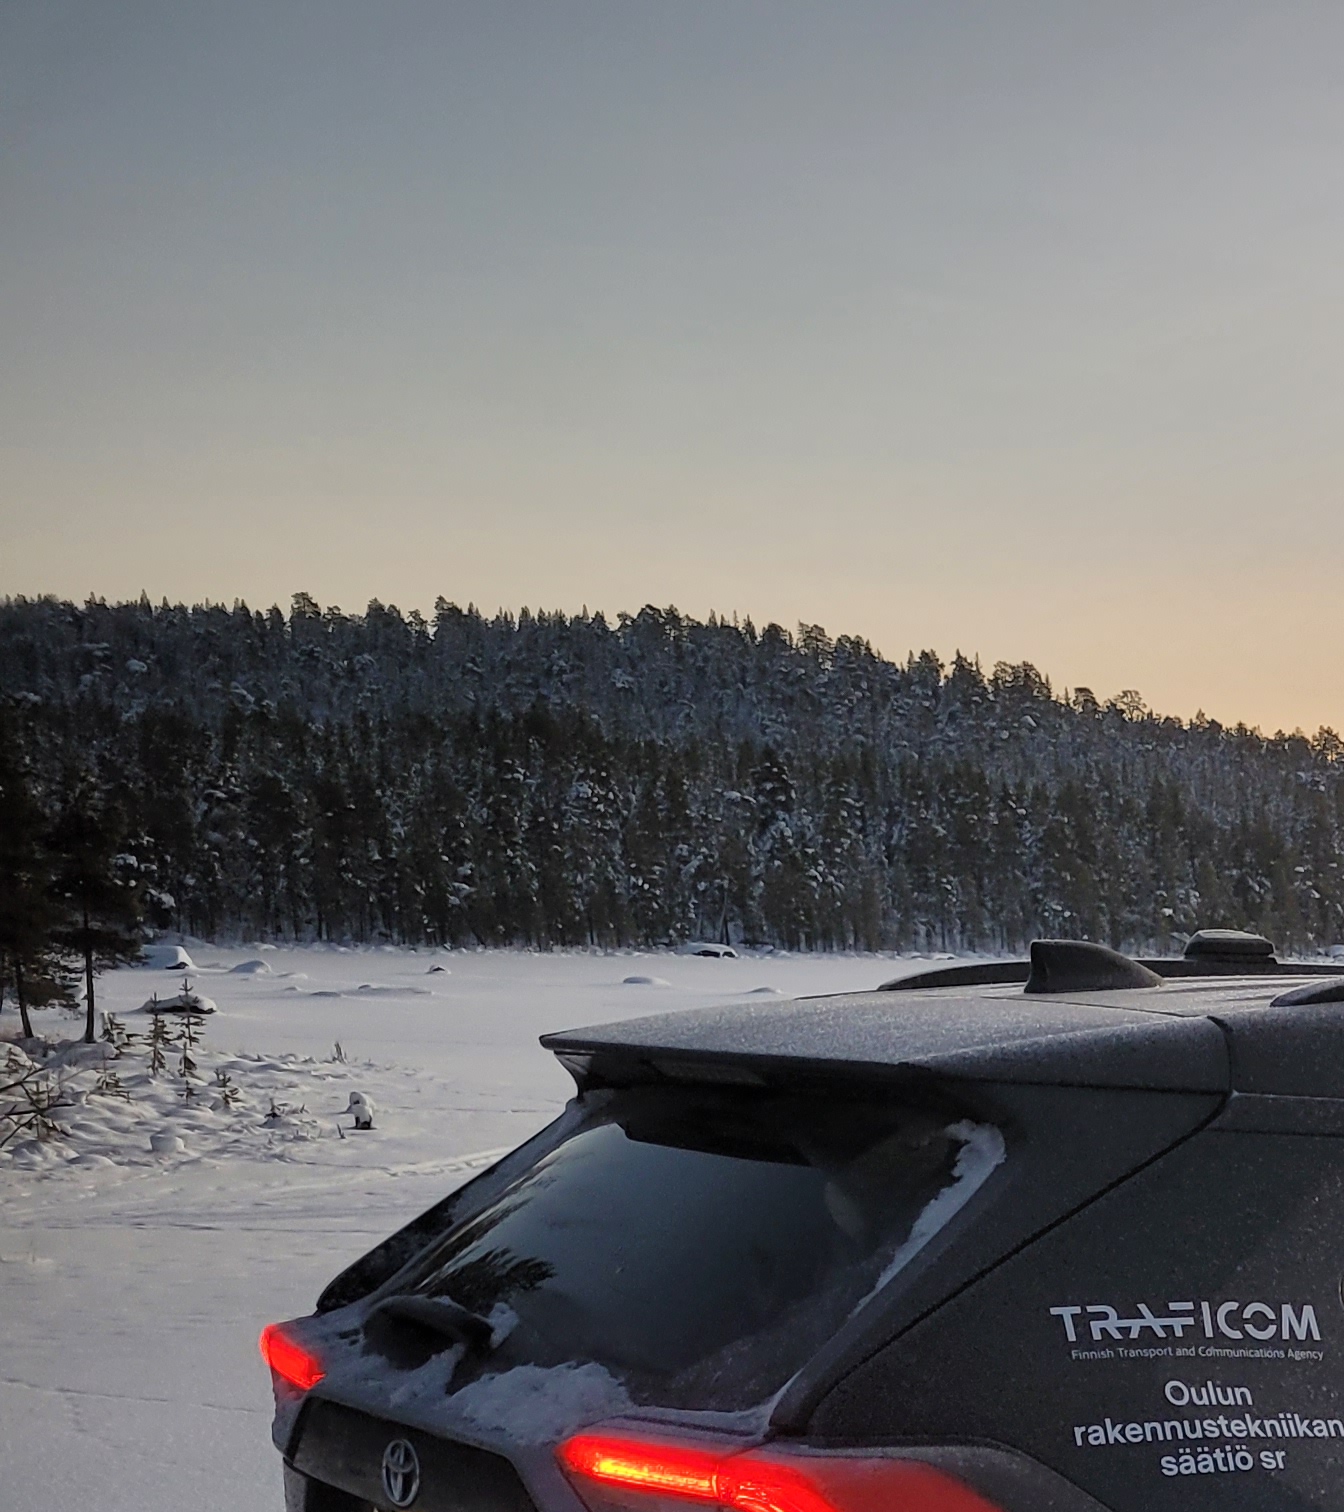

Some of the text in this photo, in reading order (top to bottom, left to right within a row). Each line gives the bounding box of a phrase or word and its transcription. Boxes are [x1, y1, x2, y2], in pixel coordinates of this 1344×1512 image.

[1050, 1301, 1321, 1342] TRAFICOM
[1071, 1346, 1324, 1361] Finnish Transport and Communications Agency
[1164, 1380, 1253, 1406] Oulun
[1160, 1445, 1286, 1477] säätiö sr
